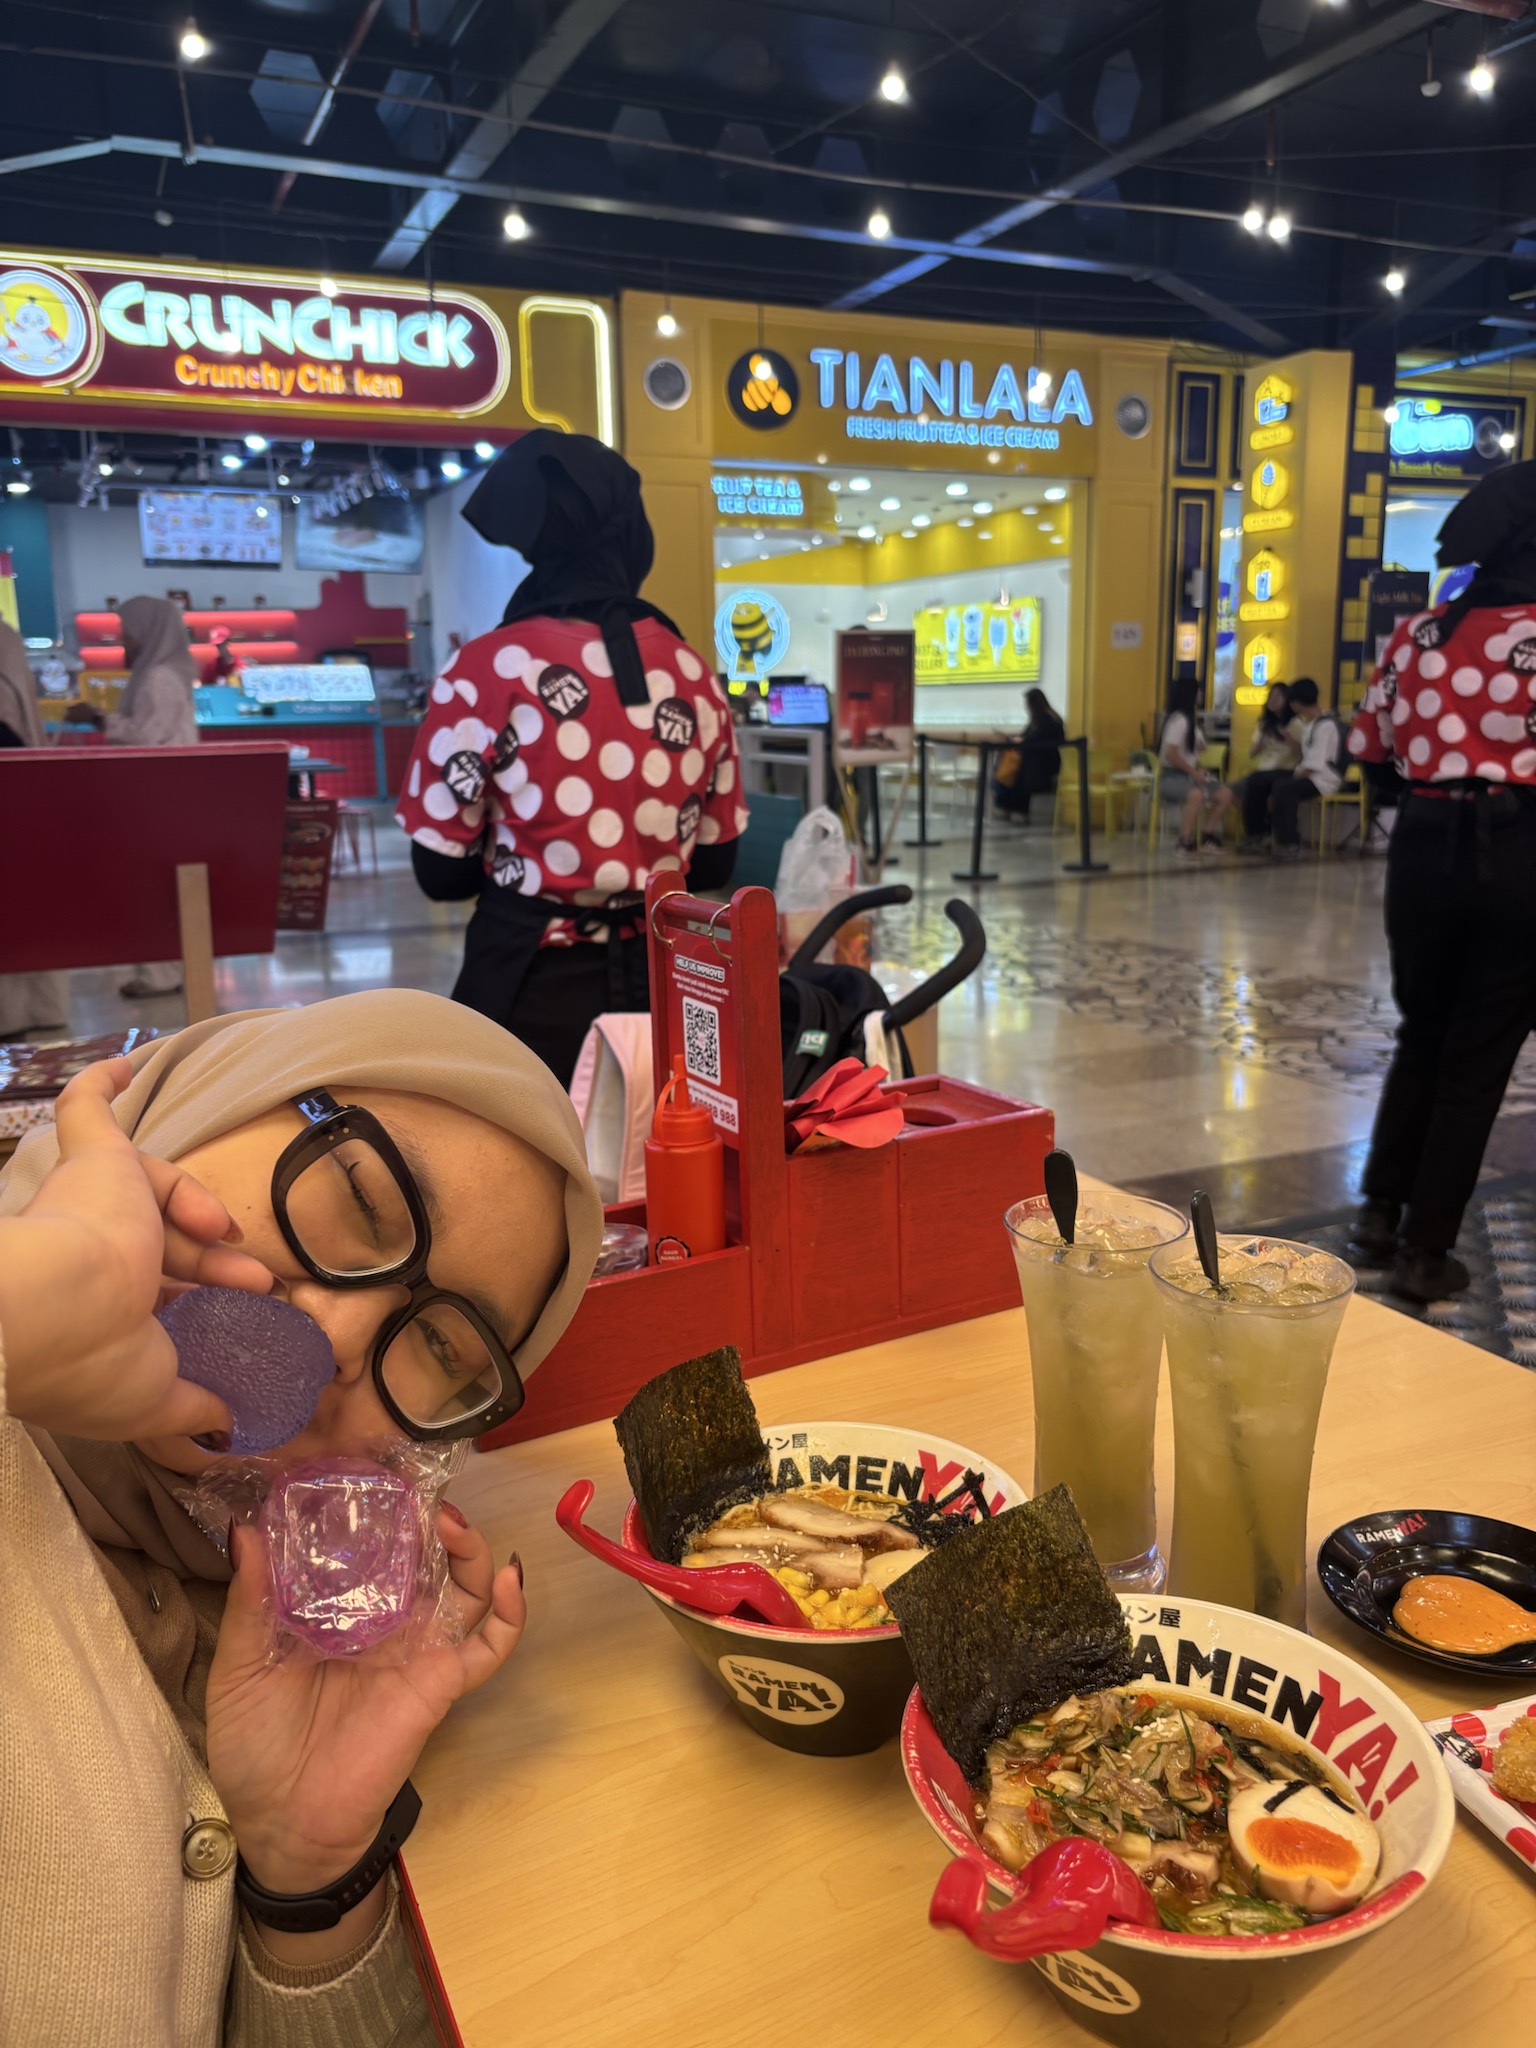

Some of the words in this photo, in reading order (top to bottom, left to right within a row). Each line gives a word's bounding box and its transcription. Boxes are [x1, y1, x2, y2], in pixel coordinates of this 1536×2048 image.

[100, 281, 475, 369] CRUNCHICK
[175, 354, 296, 397] Crunchy
[810, 348, 1093, 426] TIANLALA
[847, 416, 896, 441] FRESH
[980, 424, 1005, 447] ICE
[1004, 426, 1059, 450] CREAM
[754, 476, 786, 498] TEA
[717, 496, 747, 513] ICE
[548, 674, 589, 716] YA!
[657, 719, 692, 746] YA!
[763, 1433, 808, 1450] メン屋
[775, 1455, 925, 1502] AMEN
[1355, 1527, 1405, 1543] RAMEN
[1122, 1604, 1181, 1628] メン屋
[730, 1666, 819, 1691] RAMEN
[733, 1678, 838, 1712] YA!
[1132, 1634, 1324, 1738] AMEN
